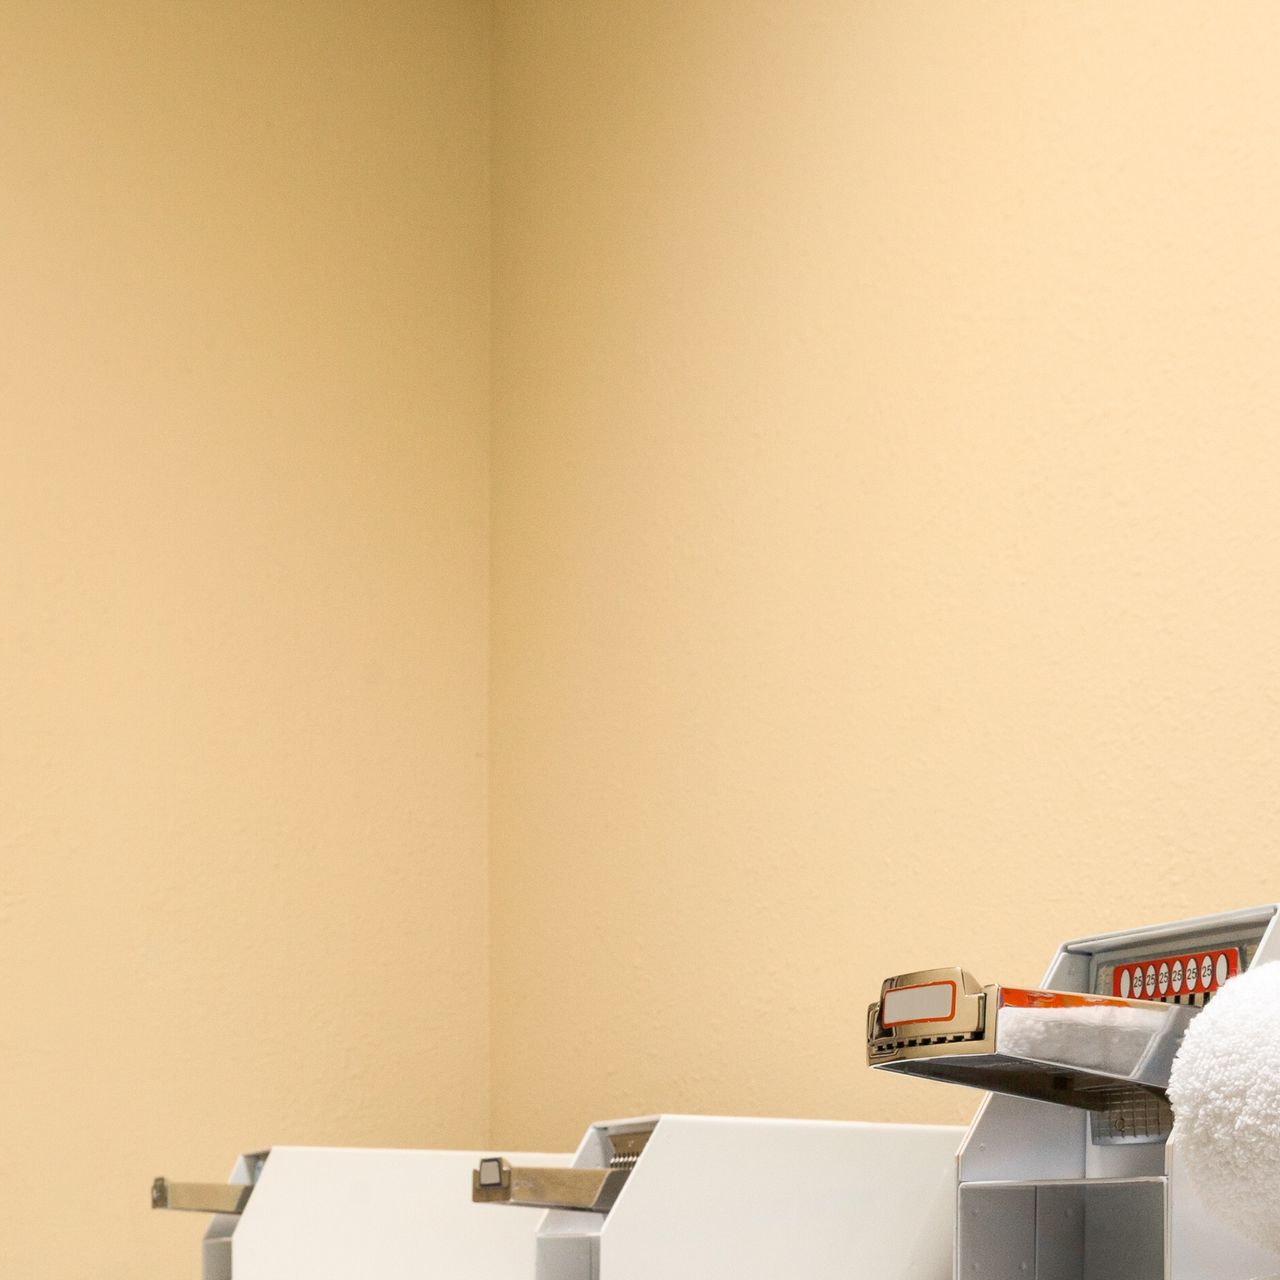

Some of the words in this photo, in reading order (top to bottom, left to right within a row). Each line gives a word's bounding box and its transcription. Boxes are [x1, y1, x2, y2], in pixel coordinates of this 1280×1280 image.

[1173, 970, 1183, 982] 25
[1187, 968, 1197, 980] 25
[1202, 965, 1213, 978] 25
[1134, 977, 1143, 988] 25
[1146, 975, 1156, 986] 25
[1159, 972, 1169, 984] 25
